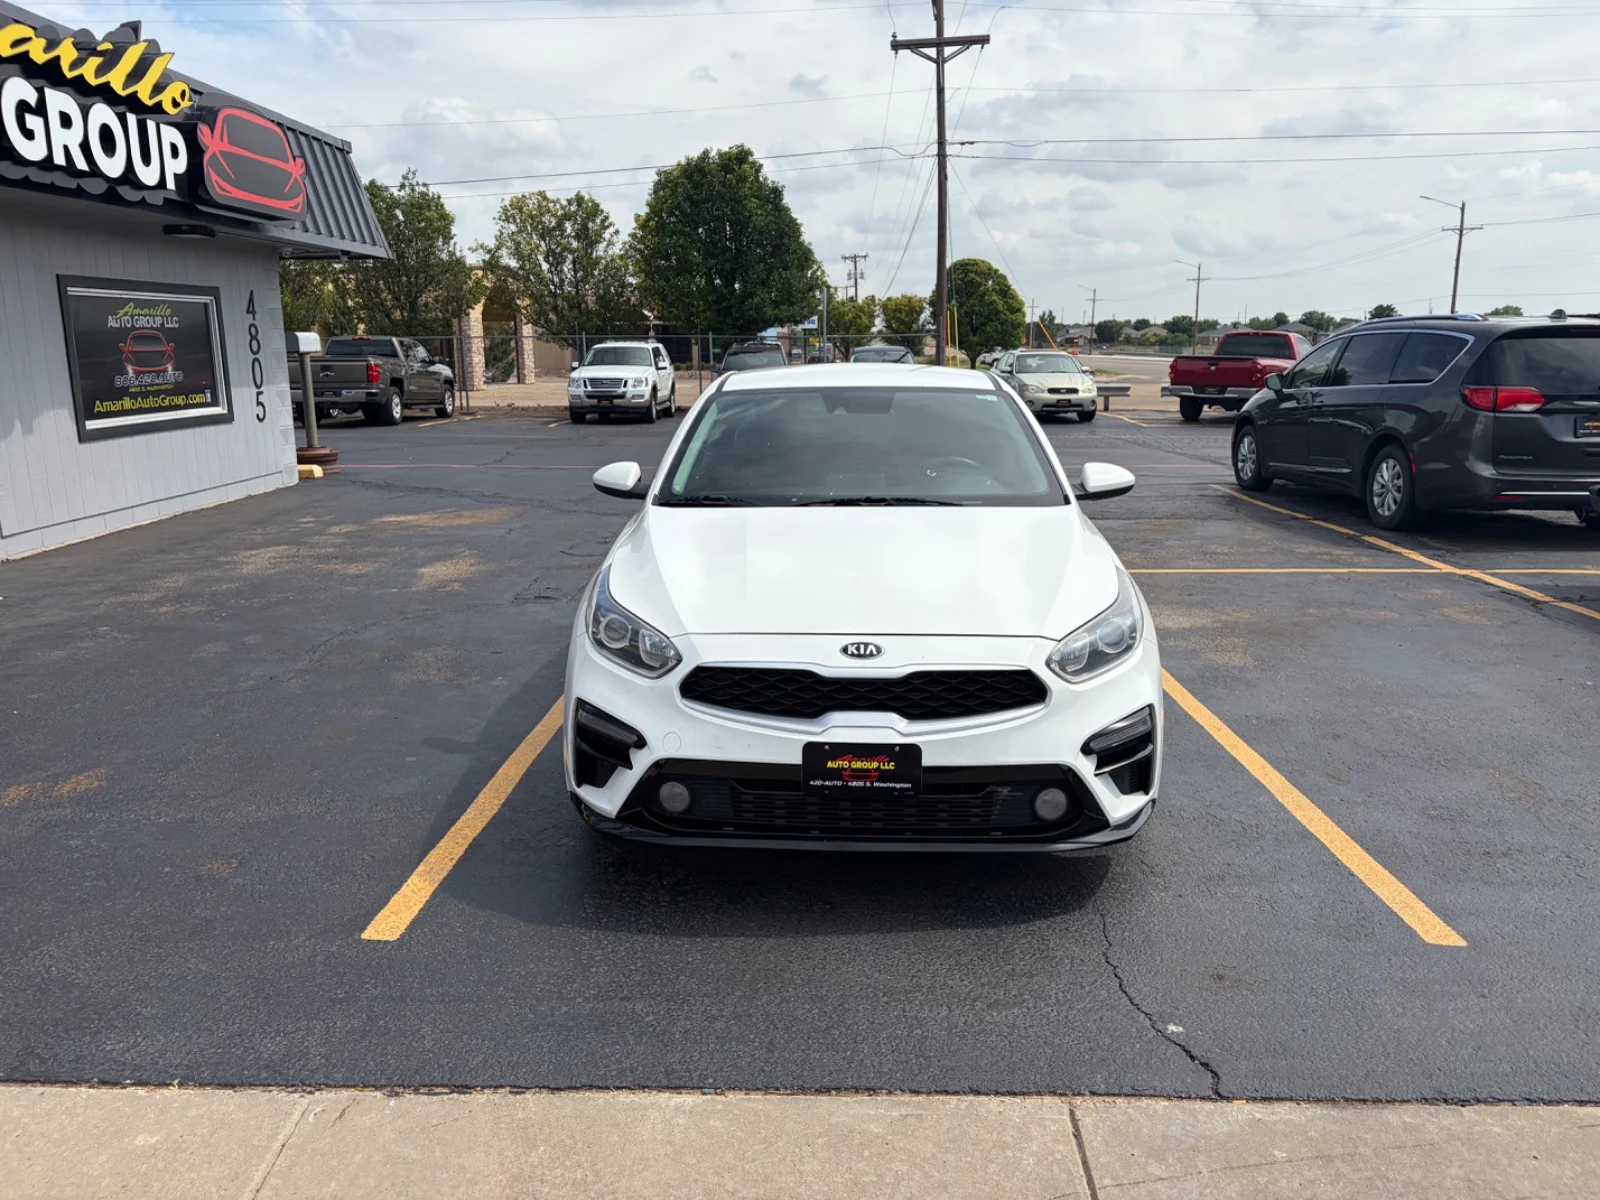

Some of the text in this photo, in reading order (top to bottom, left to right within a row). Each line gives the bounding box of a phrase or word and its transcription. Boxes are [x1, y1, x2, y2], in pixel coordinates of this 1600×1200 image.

[1, 76, 188, 190] GROUP
[116, 301, 172, 318] Amarillo
[107, 315, 179, 328] AUTO GROUP LLC
[246, 289, 266, 423] 4805
[94, 393, 205, 414] AmarilloAutoGroup.com
[847, 643, 878, 655] KIA
[826, 760, 896, 770] AUTO GROUP LLC
[873, 782, 912, 790] Washington
